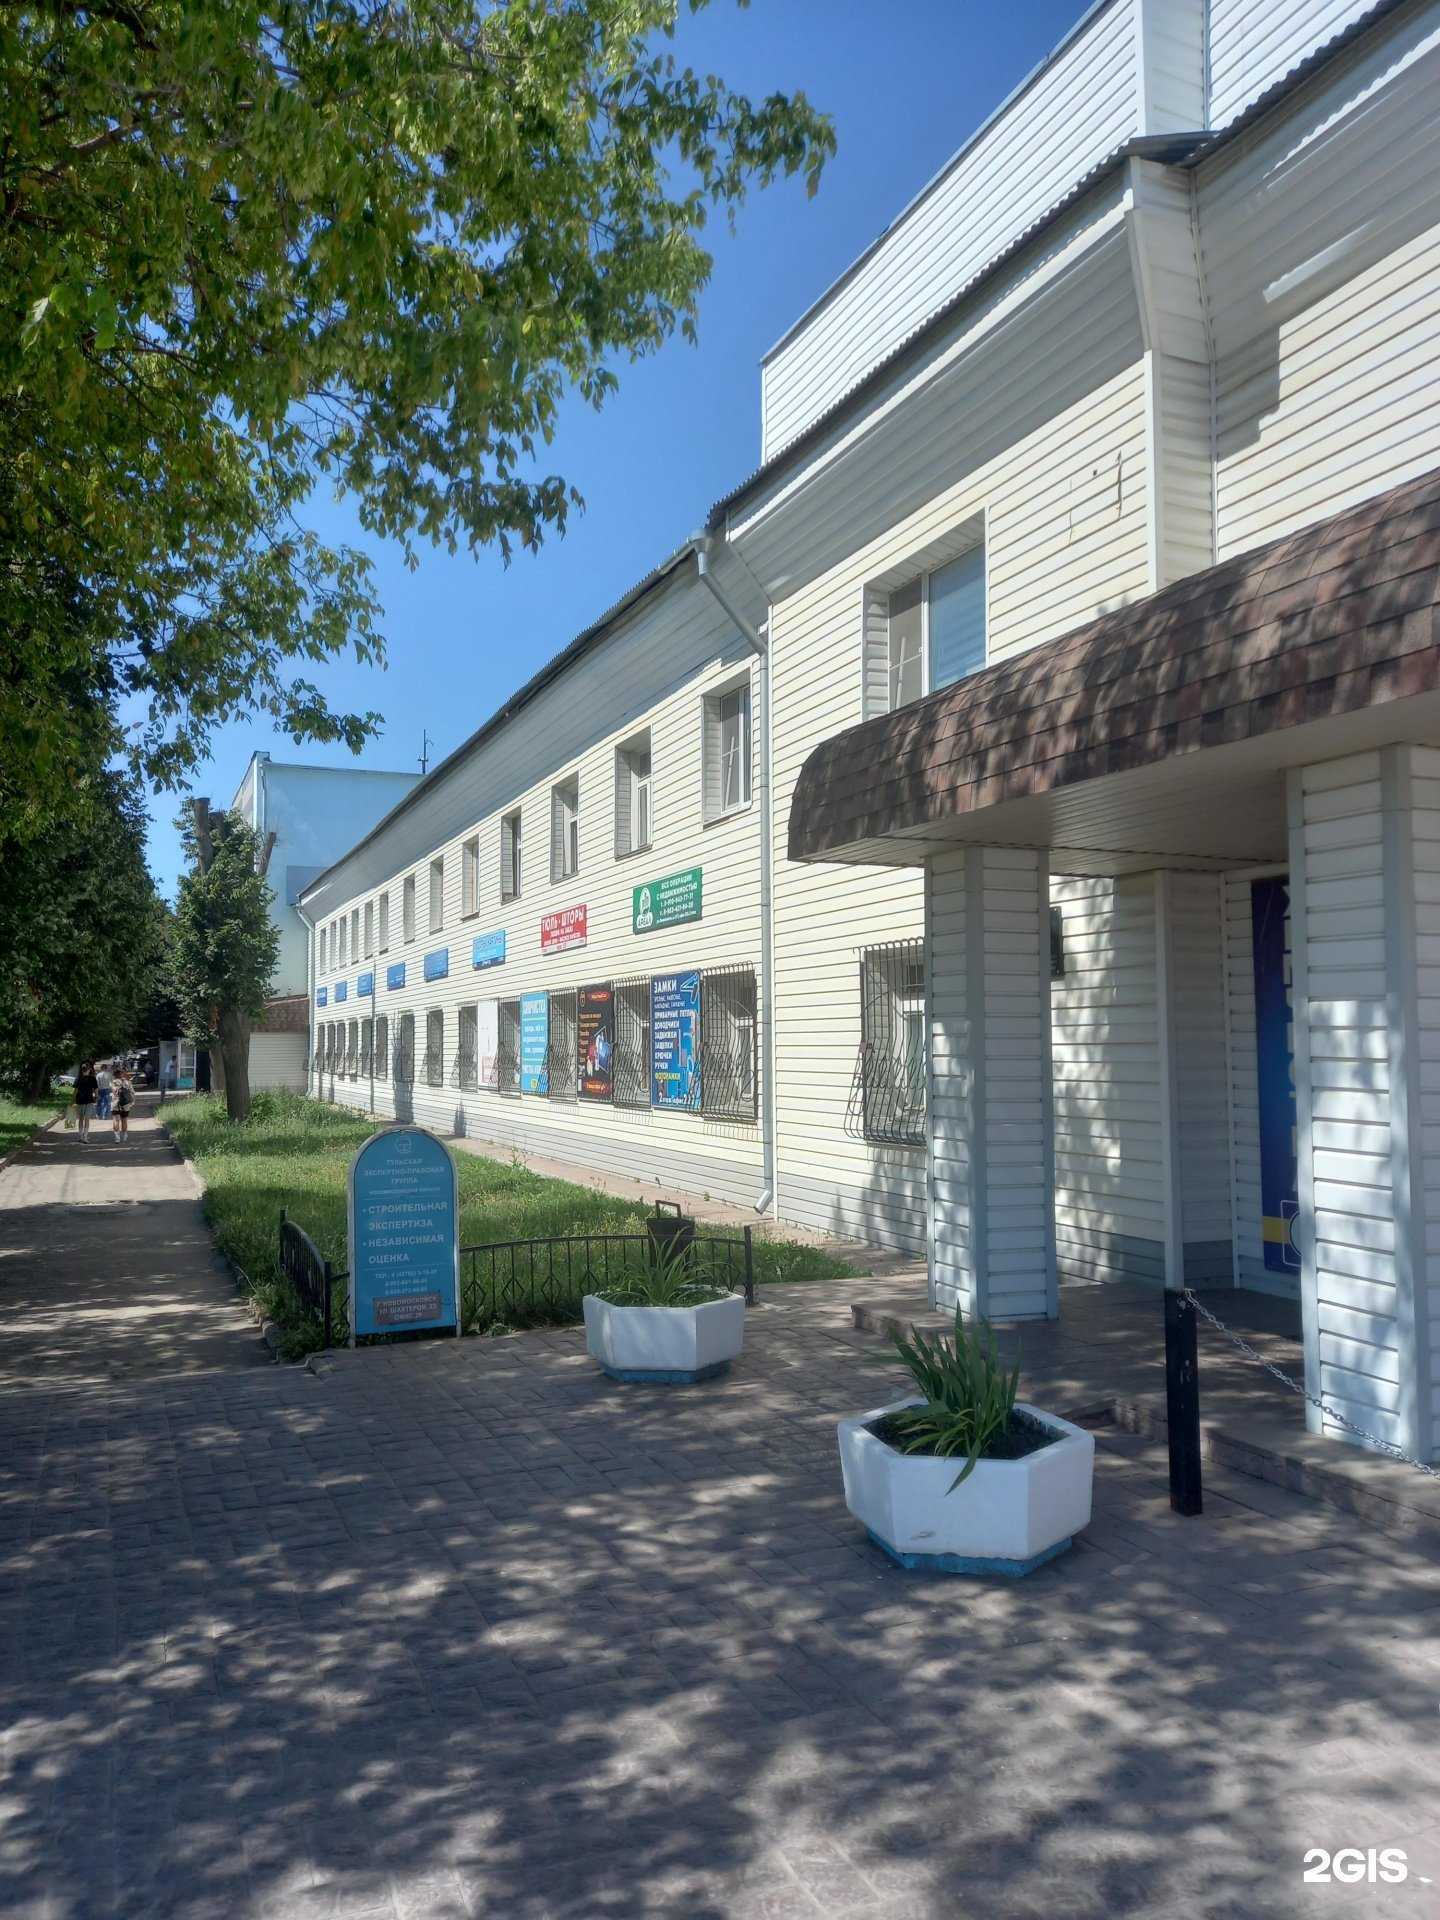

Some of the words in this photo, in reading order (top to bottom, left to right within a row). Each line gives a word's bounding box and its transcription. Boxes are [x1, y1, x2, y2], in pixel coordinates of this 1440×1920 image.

[542, 916, 558, 933] ТЮЛЬ
[561, 907, 585, 927] ШТОРЫ
[654, 979, 677, 994] ЗАМКИ
[655, 1051, 673, 1060] КРЮЧКИ
[655, 1062, 669, 1070] РУЧКИ
[368, 1201, 448, 1214] СТРОИТЕЛЬНАЯ
[368, 1219, 433, 1231] ЭКСПЕРТИЗА
[368, 1233, 444, 1248] НЕЗАВИСИМАЯ
[368, 1252, 410, 1265] ОЦЕНКА
